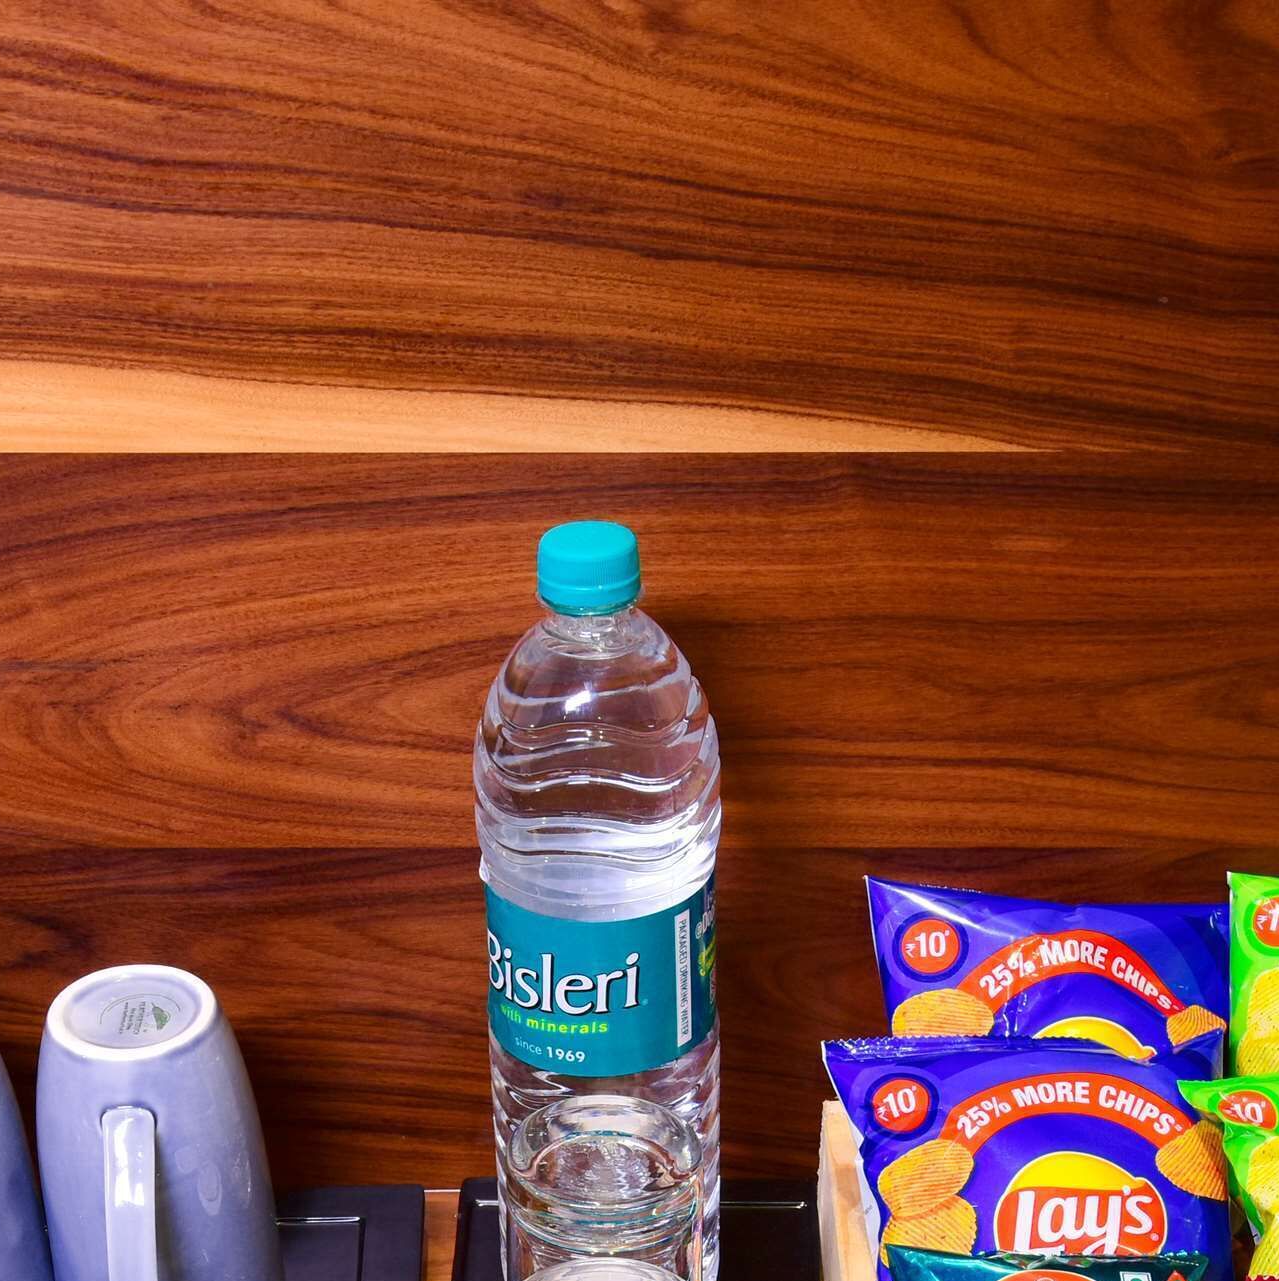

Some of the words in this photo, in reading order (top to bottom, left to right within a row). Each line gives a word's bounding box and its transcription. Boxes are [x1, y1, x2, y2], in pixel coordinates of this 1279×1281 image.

[487, 928, 639, 1015] Bisleri
[979, 951, 1036, 998] 25%
[1038, 938, 1108, 969] MORE
[1111, 957, 1172, 1010] CHIPS
[500, 1003, 521, 1023] with
[526, 1017, 608, 1034] minerals
[514, 1036, 542, 1055] since
[546, 1046, 586, 1063] 1969
[956, 1096, 1012, 1141] 25%
[1011, 1080, 1090, 1107] MORE
[1099, 1084, 1175, 1135] CHIPS
[1014, 1186, 1154, 1255] Lay's
